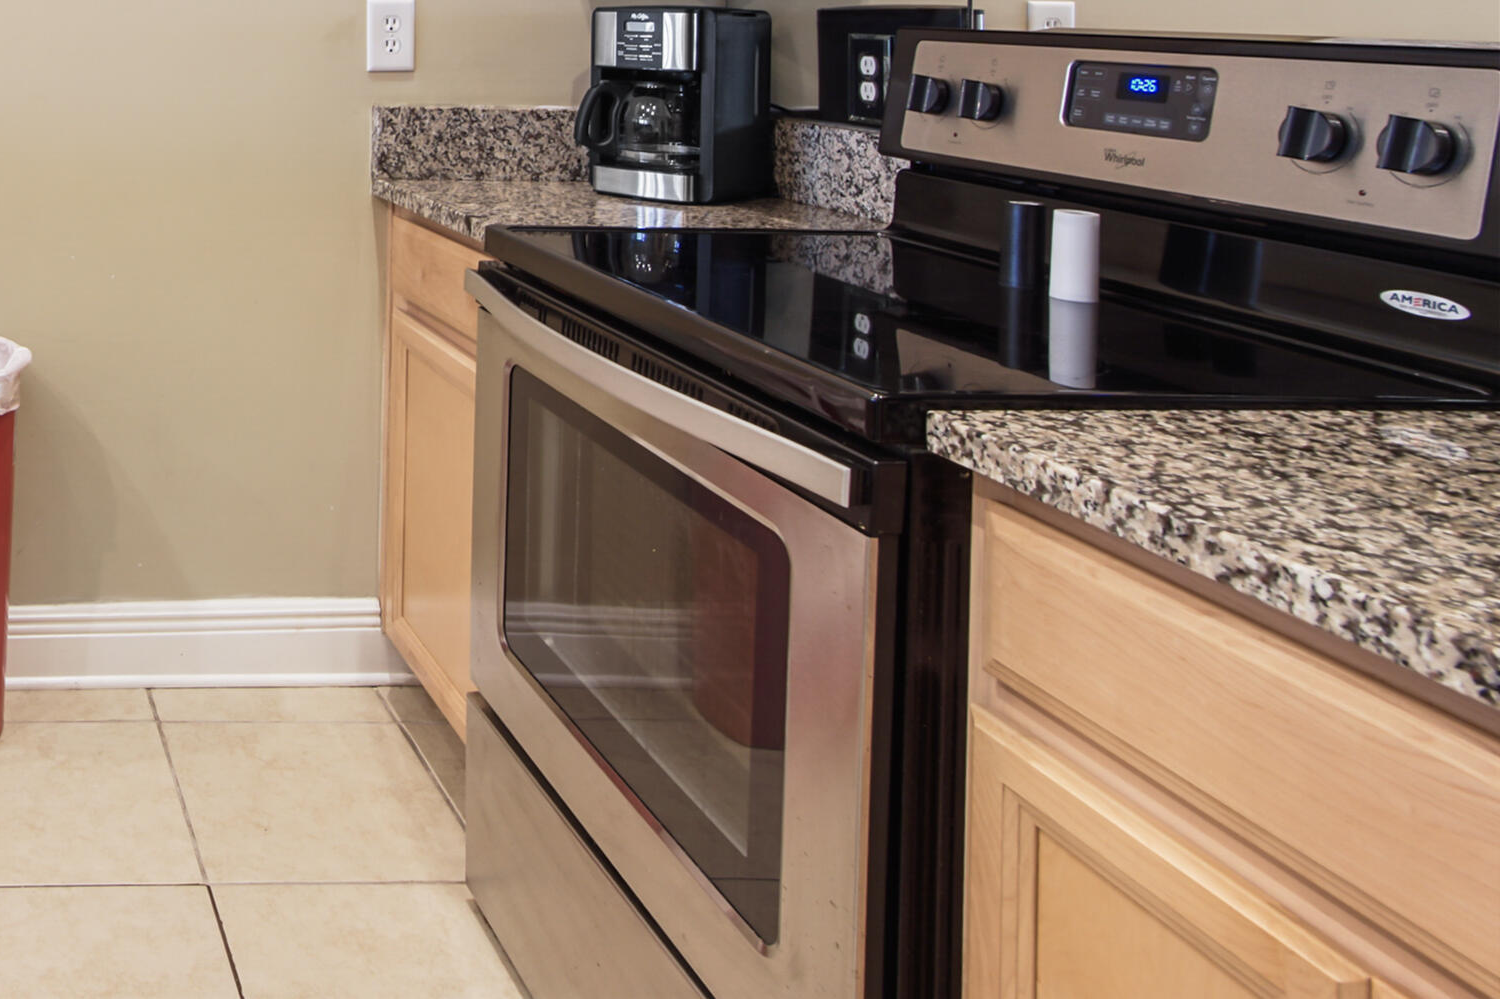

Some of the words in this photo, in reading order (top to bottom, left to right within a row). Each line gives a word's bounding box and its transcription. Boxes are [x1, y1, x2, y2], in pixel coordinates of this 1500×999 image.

[1129, 78, 1157, 93] 10:26
[1104, 152, 1145, 166] Whirlpool
[1390, 293, 1458, 314] AMERICA
